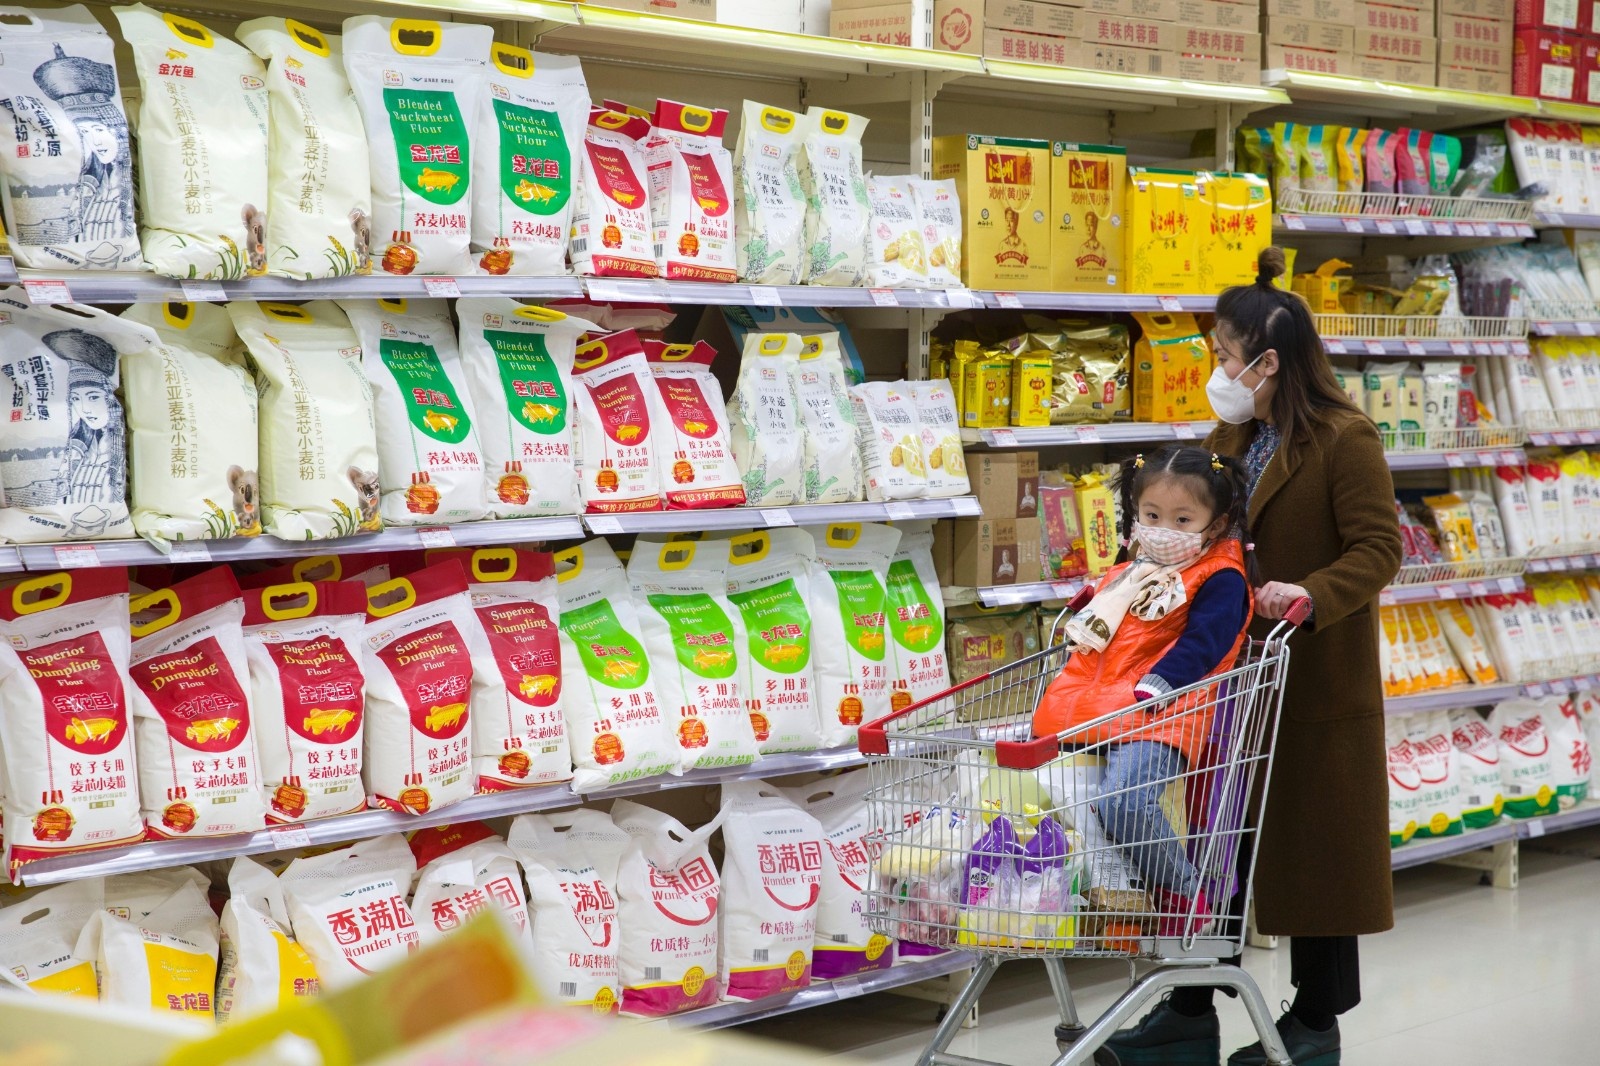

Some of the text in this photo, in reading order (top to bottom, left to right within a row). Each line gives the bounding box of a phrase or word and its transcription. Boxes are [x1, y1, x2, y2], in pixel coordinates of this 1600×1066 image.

[159, 64, 195, 78] 金龙鱼
[398, 98, 442, 111] Blended
[392, 110, 455, 123] Buckwheat
[504, 111, 547, 127] Blended
[410, 123, 442, 134] Flour
[501, 120, 559, 138] Buckwheat
[516, 134, 547, 146] Flour
[409, 144, 463, 165] 金龙鱼
[512, 154, 560, 179] 金龙鱼
[203, 179, 213, 215] FLOUR
[414, 213, 467, 229] 荞麦小麦粉
[496, 339, 535, 352] Blended
[510, 361, 537, 372] Flour
[412, 387, 453, 409] 金龙鱼
[512, 380, 559, 398] 金龙鱼
[1105, 383, 1115, 402] 小米
[188, 403, 199, 442] WHEAT
[313, 407, 326, 480] WHEAT FLOUR
[842, 582, 874, 593] Purpose
[751, 590, 792, 610] Purpose
[490, 605, 536, 622] Superior
[675, 602, 712, 617] Purpose
[756, 605, 783, 619] Flour
[493, 617, 548, 635] Dumpling
[569, 613, 610, 633] Purpose
[680, 616, 704, 626] Flour
[395, 630, 444, 654] Superior
[513, 634, 536, 644] Flour
[26, 645, 86, 666] Superior
[148, 651, 204, 675] Superior
[284, 651, 346, 668] Dumpling
[397, 642, 458, 667] Dumpling
[509, 649, 557, 672] 金龙鱼
[909, 653, 943, 671] 多用途
[29, 657, 102, 680] Dumpling
[305, 667, 332, 677] Flour
[422, 660, 446, 672] Flour
[57, 678, 84, 687] Flour
[151, 661, 219, 692] Dumpling
[765, 677, 807, 692] 多用途
[910, 667, 944, 684] 麦芯小麦粉
[178, 679, 205, 691] Flour
[298, 681, 356, 705] 金龙鱼
[417, 674, 467, 704] 金龙鱼
[52, 691, 115, 714] 金龙鱼
[173, 692, 235, 720] 金龙鱼
[611, 691, 655, 710] 多用途
[765, 691, 809, 705] 麦芯小麦粉
[615, 706, 659, 724] 麦芯小麦粉
[307, 747, 358, 765] 饺子专用
[427, 736, 468, 760] 饺子专用
[69, 758, 125, 777] 饺子专用
[192, 755, 247, 773] 饺子专用
[428, 750, 468, 775] 麦芯小麦粉
[193, 772, 248, 790] 麦芯小麦粉
[308, 763, 359, 781] 麦芯小麦粉
[70, 776, 127, 794] 麦芯小麦粉
[757, 840, 822, 874] 香满园
[761, 875, 797, 887] Wonder
[431, 876, 521, 933] 香满园
[560, 879, 615, 915] 满园
[341, 930, 420, 959] Wonder Farm
[167, 992, 210, 1012] 金龙鱼
